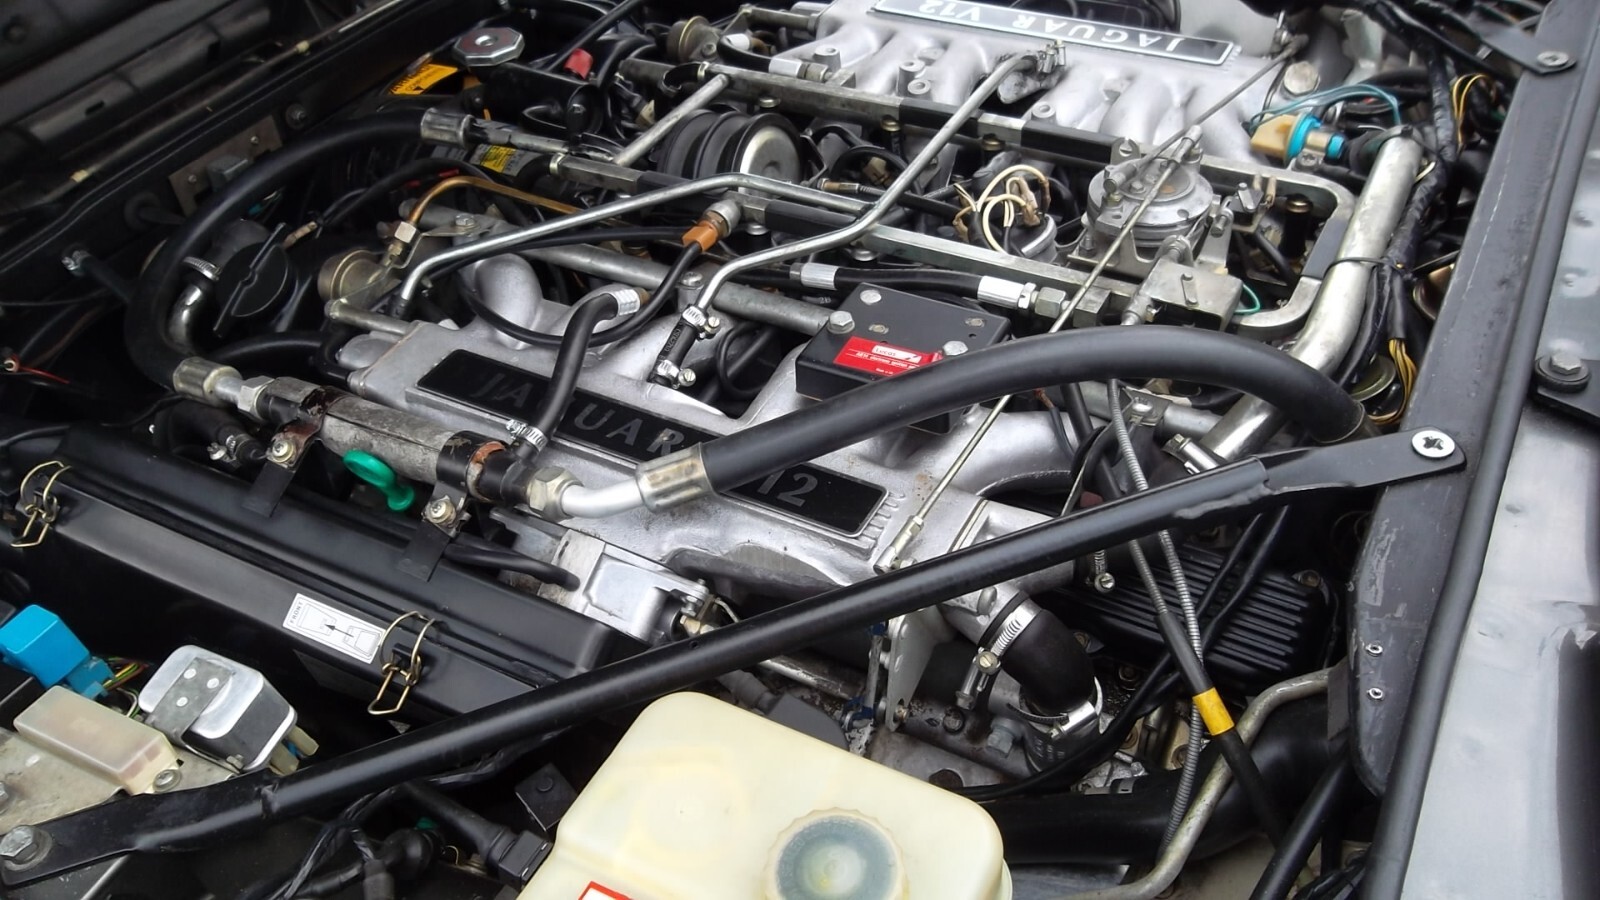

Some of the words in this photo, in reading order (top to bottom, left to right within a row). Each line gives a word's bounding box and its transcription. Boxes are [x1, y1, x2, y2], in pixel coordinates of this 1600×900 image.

[919, 2, 981, 21] V12
[1012, 14, 1186, 52] JAGUAR
[875, 347, 896, 357] Lucas
[469, 372, 685, 457] JAUAR
[756, 470, 819, 508] 12
[290, 602, 303, 623] FRONT
